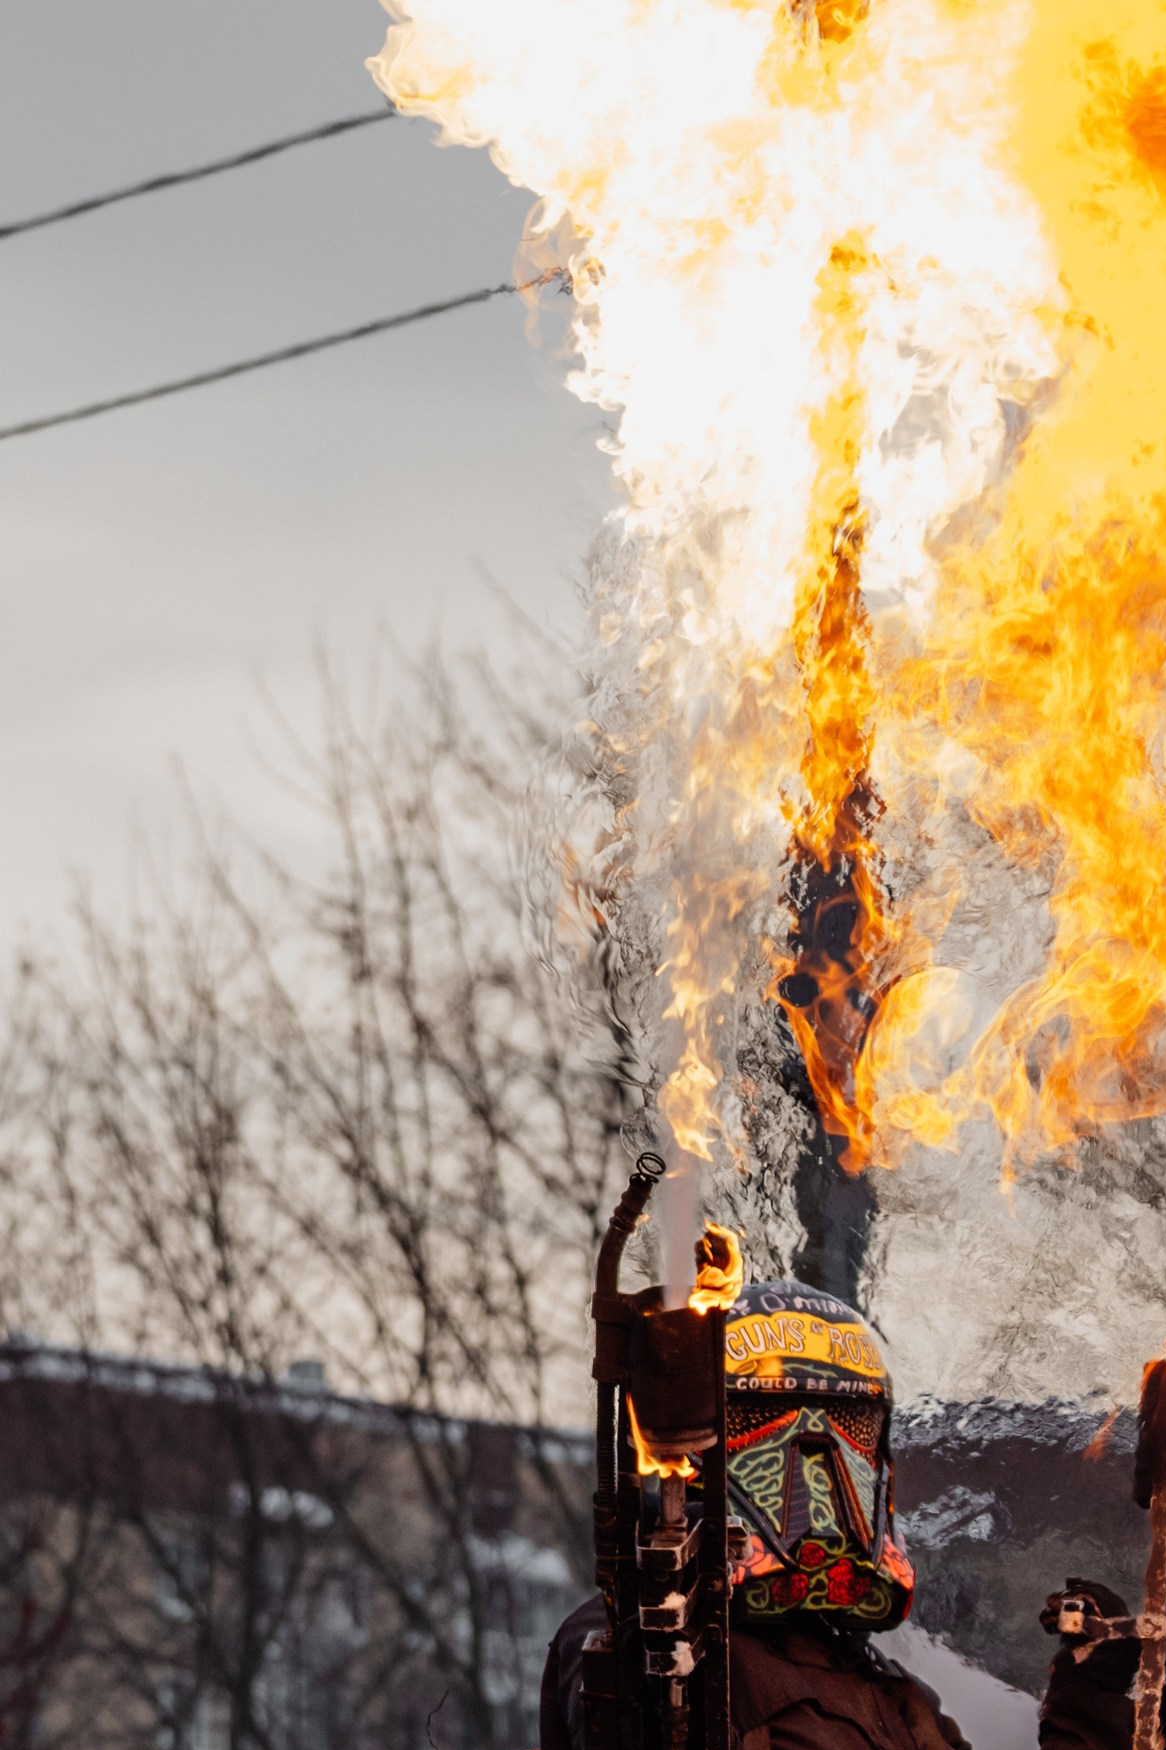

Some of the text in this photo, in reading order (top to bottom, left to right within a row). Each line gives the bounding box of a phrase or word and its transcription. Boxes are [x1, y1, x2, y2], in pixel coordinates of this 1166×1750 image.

[725, 1316, 806, 1361] GUNS
[736, 1376, 798, 1390] COULD
[806, 1377, 829, 1390] BE
